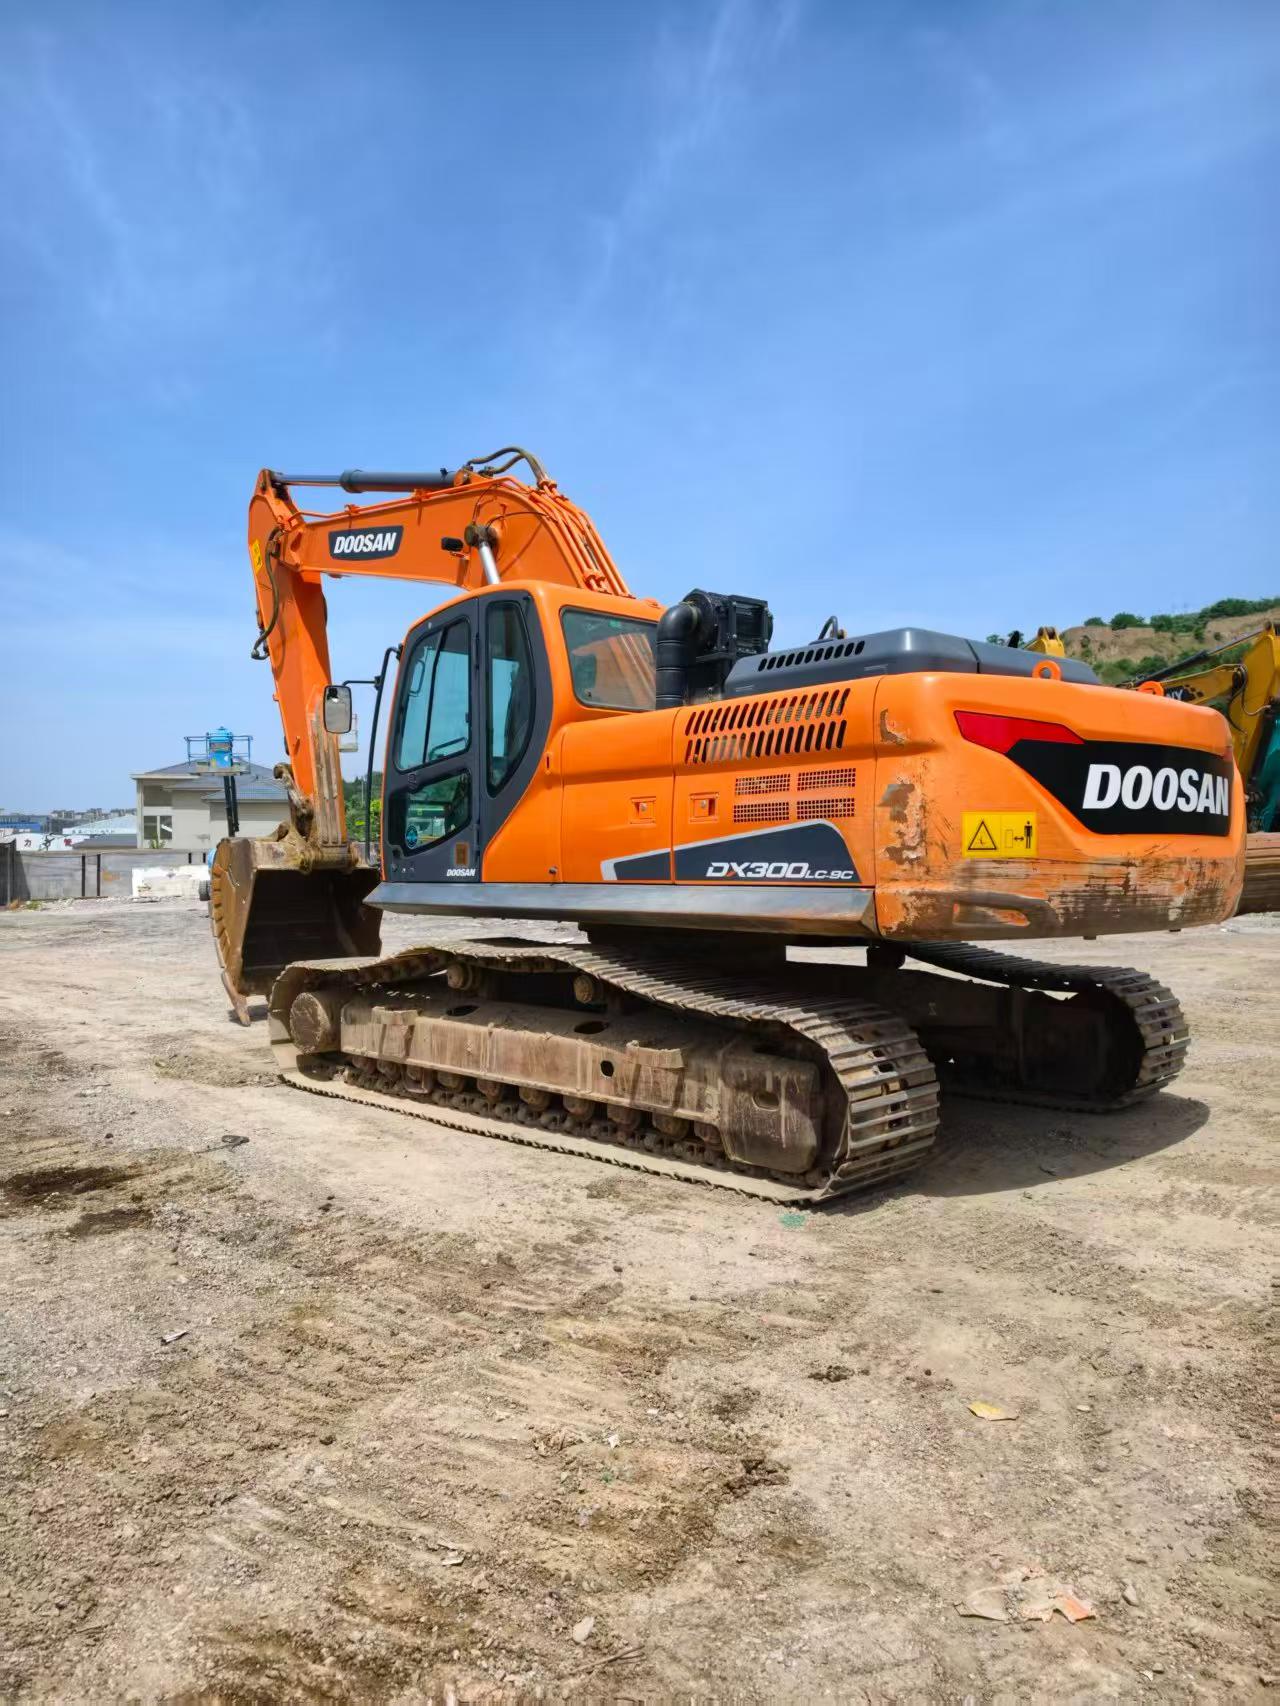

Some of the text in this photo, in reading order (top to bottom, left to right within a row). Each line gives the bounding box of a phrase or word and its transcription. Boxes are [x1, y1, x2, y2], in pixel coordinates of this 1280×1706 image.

[333, 532, 397, 554] DOOSAN
[1082, 764, 1229, 816] DOOSAN
[446, 868, 476, 877] DOOSAN
